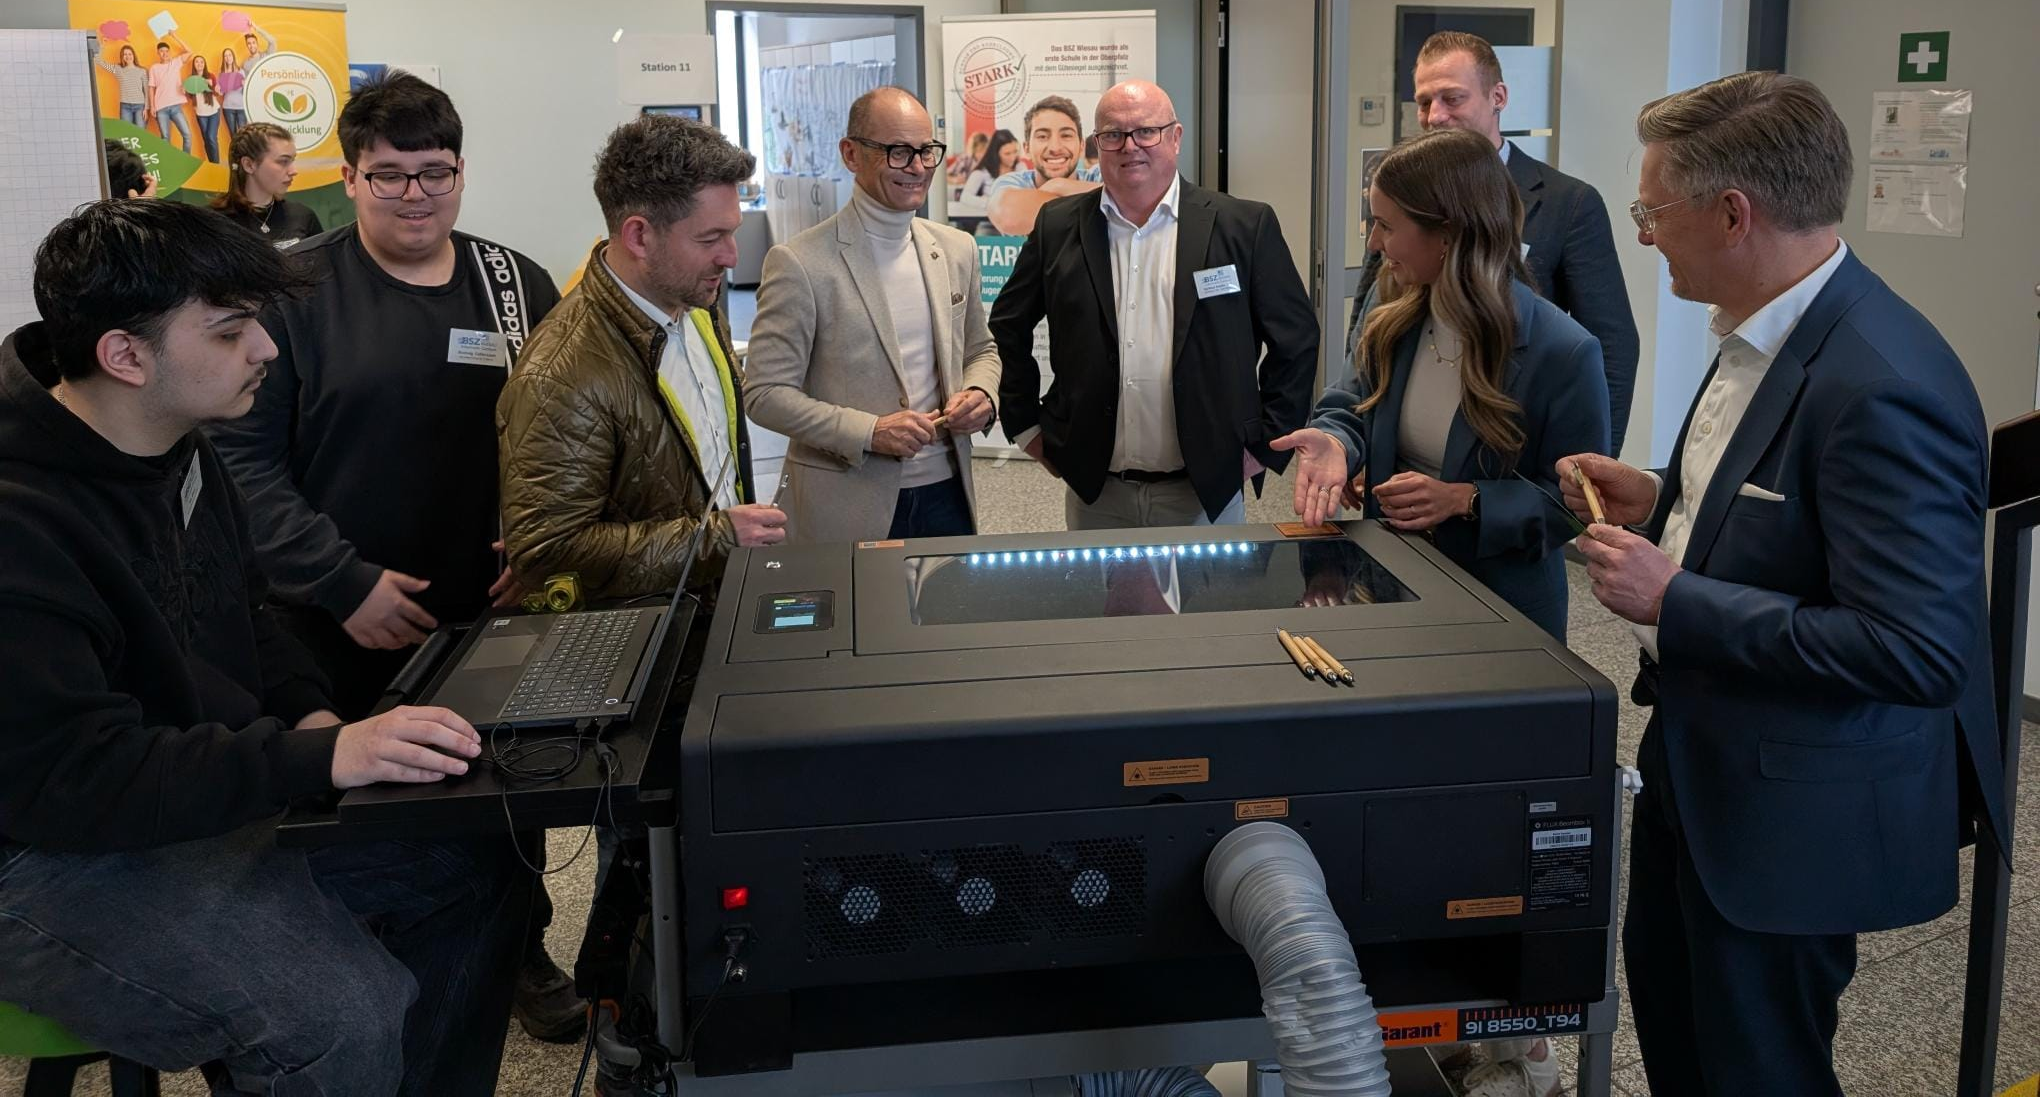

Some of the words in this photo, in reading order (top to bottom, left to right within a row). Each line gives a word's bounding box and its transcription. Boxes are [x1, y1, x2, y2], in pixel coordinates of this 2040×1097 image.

[1050, 44, 1062, 52] Das
[1119, 43, 1129, 51] als
[1044, 54, 1059, 62] erste
[1060, 54, 1080, 62] Schule
[1089, 53, 1099, 61] der
[1100, 53, 1129, 62] Oberpfalz
[640, 62, 677, 72] Station
[679, 62, 691, 72] 11
[260, 69, 317, 80] Persönliche
[964, 63, 1015, 89] STARK
[287, 124, 322, 136] icklung
[1487, 1013, 1581, 1032] 8550_T94
